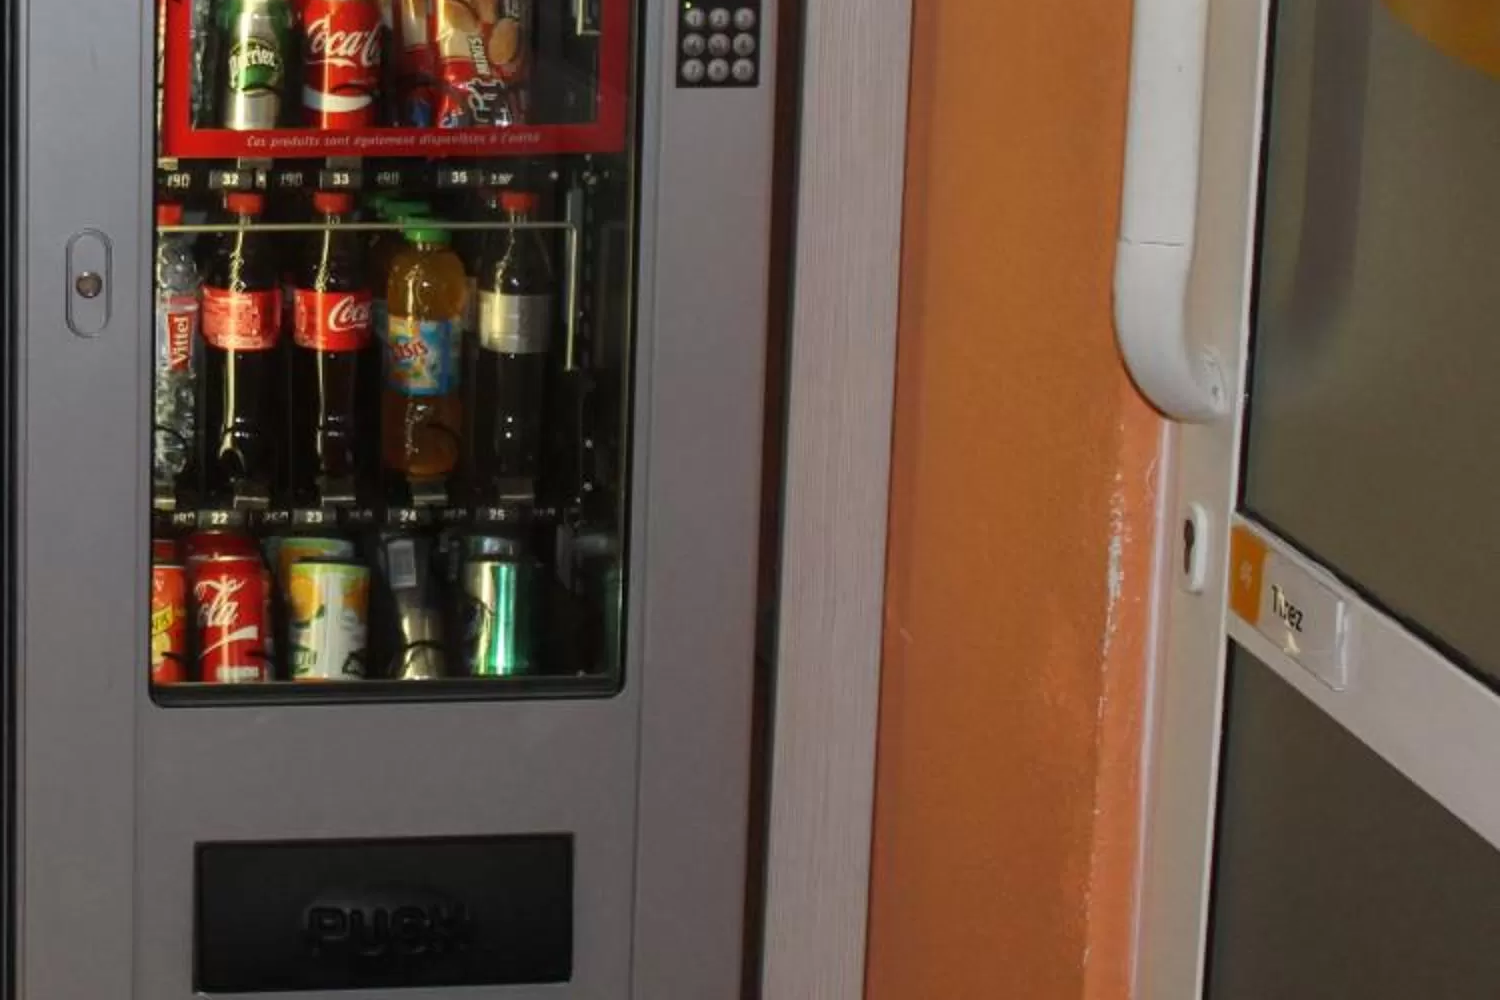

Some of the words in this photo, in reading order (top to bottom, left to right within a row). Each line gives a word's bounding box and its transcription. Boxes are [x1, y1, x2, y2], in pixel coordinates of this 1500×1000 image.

[222, 173, 240, 186] 32
[332, 173, 349, 186] 33
[171, 316, 189, 366] Vittel
[211, 512, 229, 525] 22
[306, 511, 324, 523] 23
[302, 901, 471, 957] PUSH
